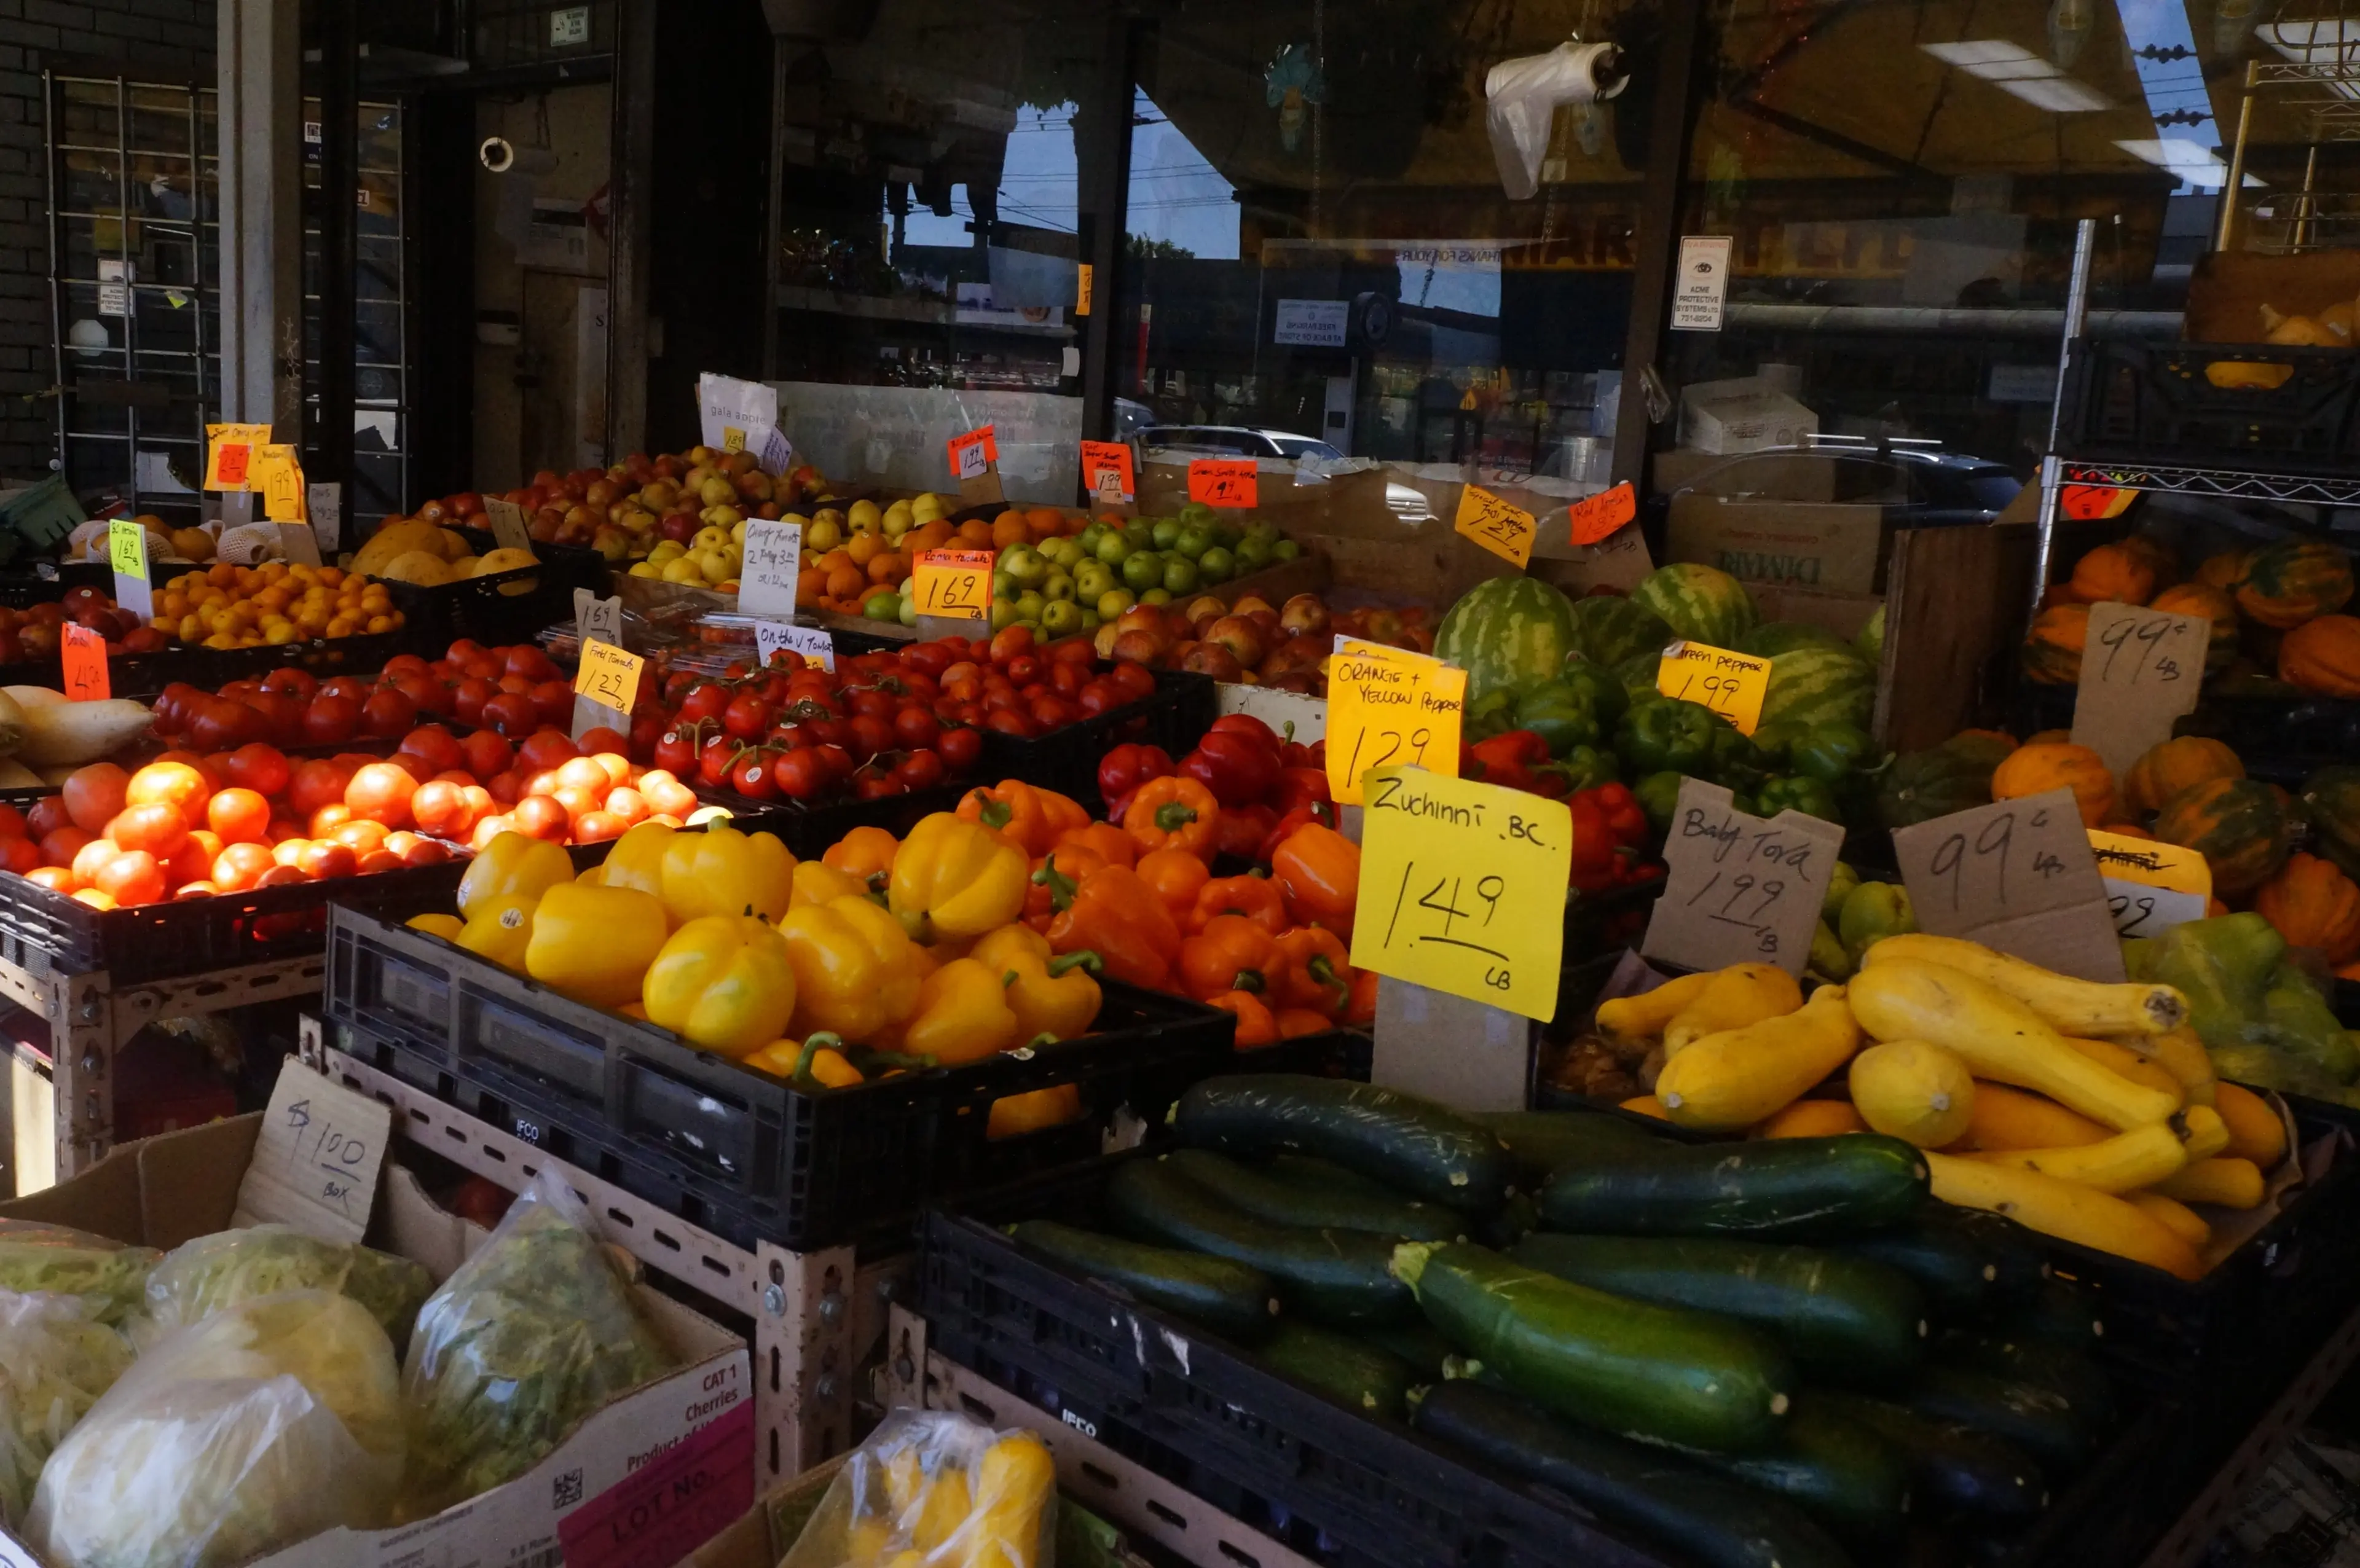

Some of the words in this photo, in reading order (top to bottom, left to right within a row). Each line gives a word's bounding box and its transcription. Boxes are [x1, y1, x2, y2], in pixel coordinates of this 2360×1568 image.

[711, 406, 731, 417] gala
[736, 412, 765, 425] apple
[748, 550, 757, 563] 2
[1339, 663, 1402, 683] ORANGE
[1359, 684, 1412, 704] YELLOW
[517, 1119, 538, 1140] IFCO
[703, 1369, 726, 1392] CAT
[730, 1363, 737, 1379] 1
[685, 1389, 738, 1422] Cherries
